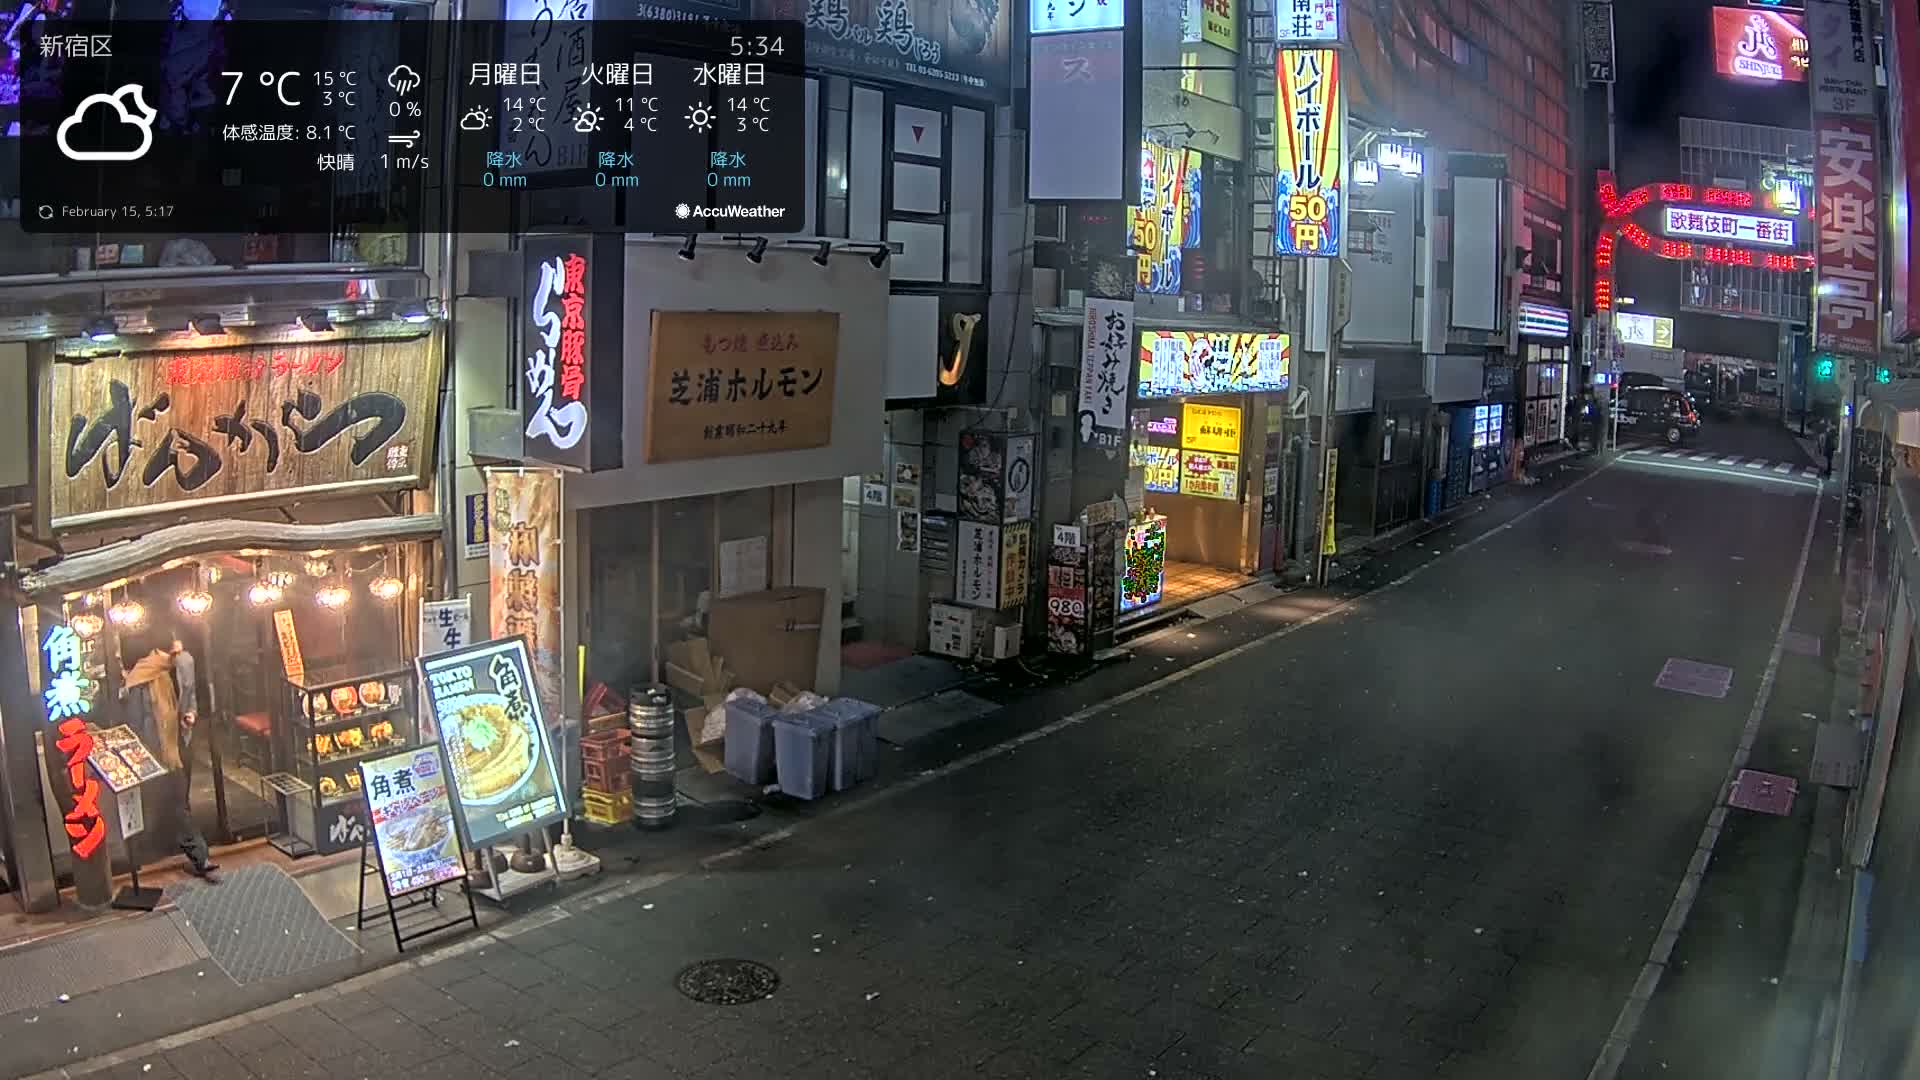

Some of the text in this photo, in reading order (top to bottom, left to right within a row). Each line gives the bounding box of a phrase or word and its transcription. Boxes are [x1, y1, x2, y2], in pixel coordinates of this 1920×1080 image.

[1590, 63, 1609, 79] 7F
[1294, 53, 1323, 190] ハイボール
[1289, 194, 1327, 251] 50円
[1670, 210, 1790, 243] 歌舞伎町一番街
[1818, 126, 1877, 330] 安楽亭
[561, 253, 586, 400] 東京豚骨
[669, 366, 824, 406] 芝浦ホルモン
[370, 768, 416, 801] 角煮
